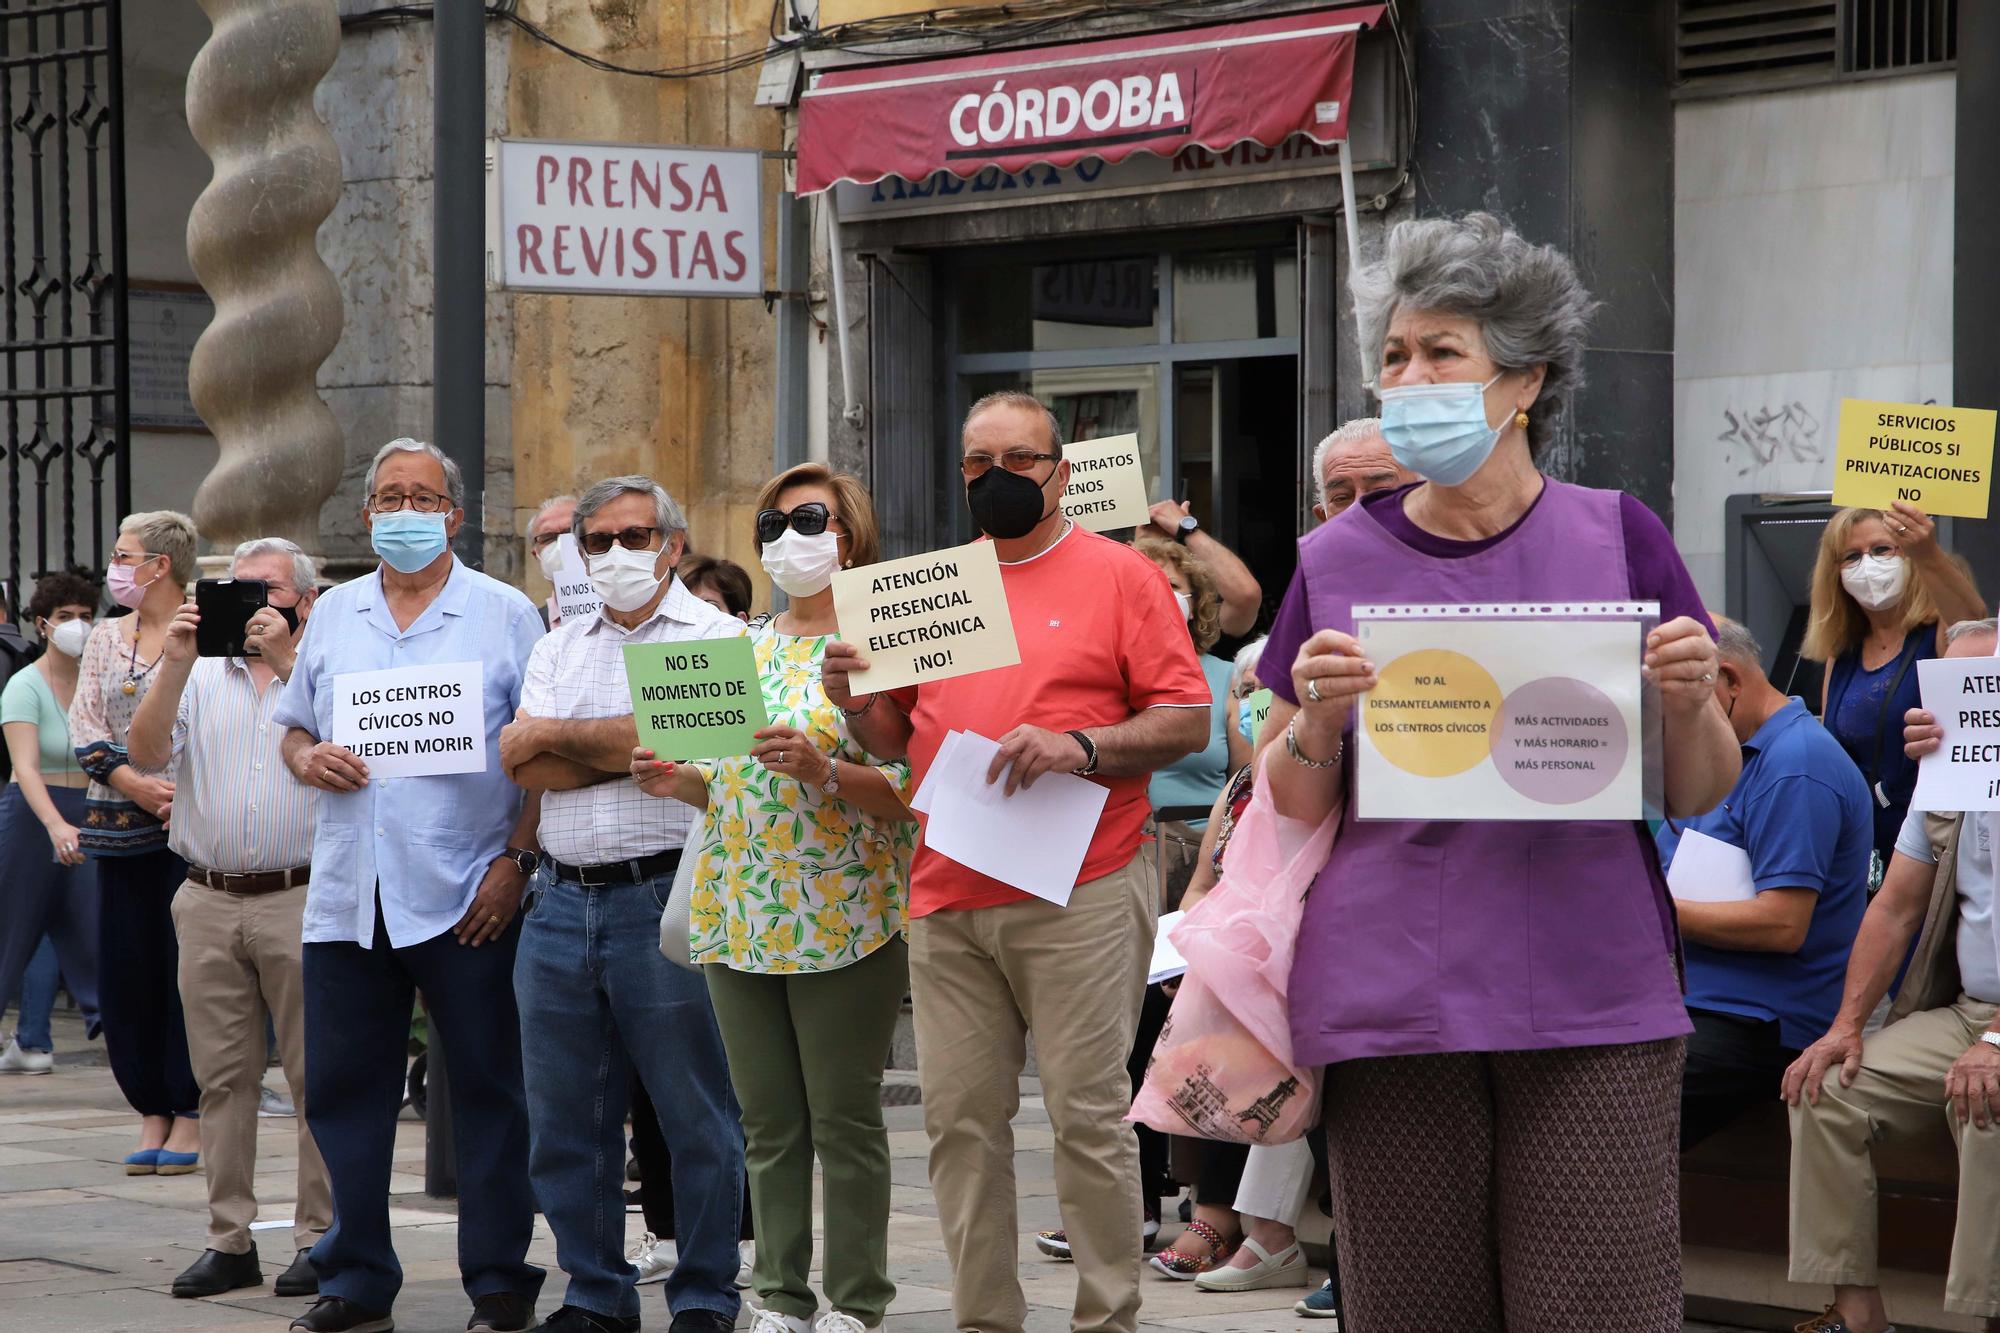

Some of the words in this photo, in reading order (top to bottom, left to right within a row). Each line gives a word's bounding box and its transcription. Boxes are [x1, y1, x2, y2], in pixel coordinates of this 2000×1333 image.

[948, 73, 1185, 147] CÓRDOBA
[536, 155, 728, 213] PRENSA
[517, 224, 747, 282] REVISTAS
[1877, 413, 1956, 432] SERVICIOS
[1869, 435, 1944, 455] PÚBLICOS
[1946, 443, 1961, 456] SI
[1846, 459, 1981, 483] PRIVATIZACIONES
[1897, 488, 1921, 501] NO
[872, 562, 959, 594] ATENCIÓN
[560, 585, 571, 597] NO
[572, 583, 589, 595] NOS
[561, 602, 596, 617] SERVICIOS
[870, 589, 972, 623] PRESENCIAL
[868, 616, 986, 652] ELECTRÓNICA
[665, 655, 688, 671] NO
[692, 654, 709, 670] ES
[913, 650, 953, 674] ¡NO!
[641, 682, 721, 701] MOMENTO
[725, 680, 747, 697] DE
[1415, 676, 1431, 686] NO
[1433, 676, 1446, 686] AL
[352, 690, 381, 706] LOS
[385, 683, 462, 702] CENTROS
[1370, 699, 1481, 710] DESMANTELAMIENTO
[1483, 700, 1491, 709] A
[358, 712, 423, 731] CÍVICOS
[428, 710, 454, 726] NO
[651, 709, 746, 730] RETROCESOS
[1375, 723, 1395, 733] LOS
[1396, 723, 1443, 733] CENTROS
[1446, 720, 1487, 734] CÍVICOS
[1514, 714, 1539, 727] MÁS
[1541, 716, 1609, 727] ACTIVIDADES
[414, 736, 474, 754] MORIR
[1514, 738, 1521, 748] Y
[1523, 735, 1547, 748] MÁS
[1549, 738, 1599, 749] HORARIO
[1514, 757, 1539, 770] MÁS
[1541, 759, 1596, 771] PERSONAL
